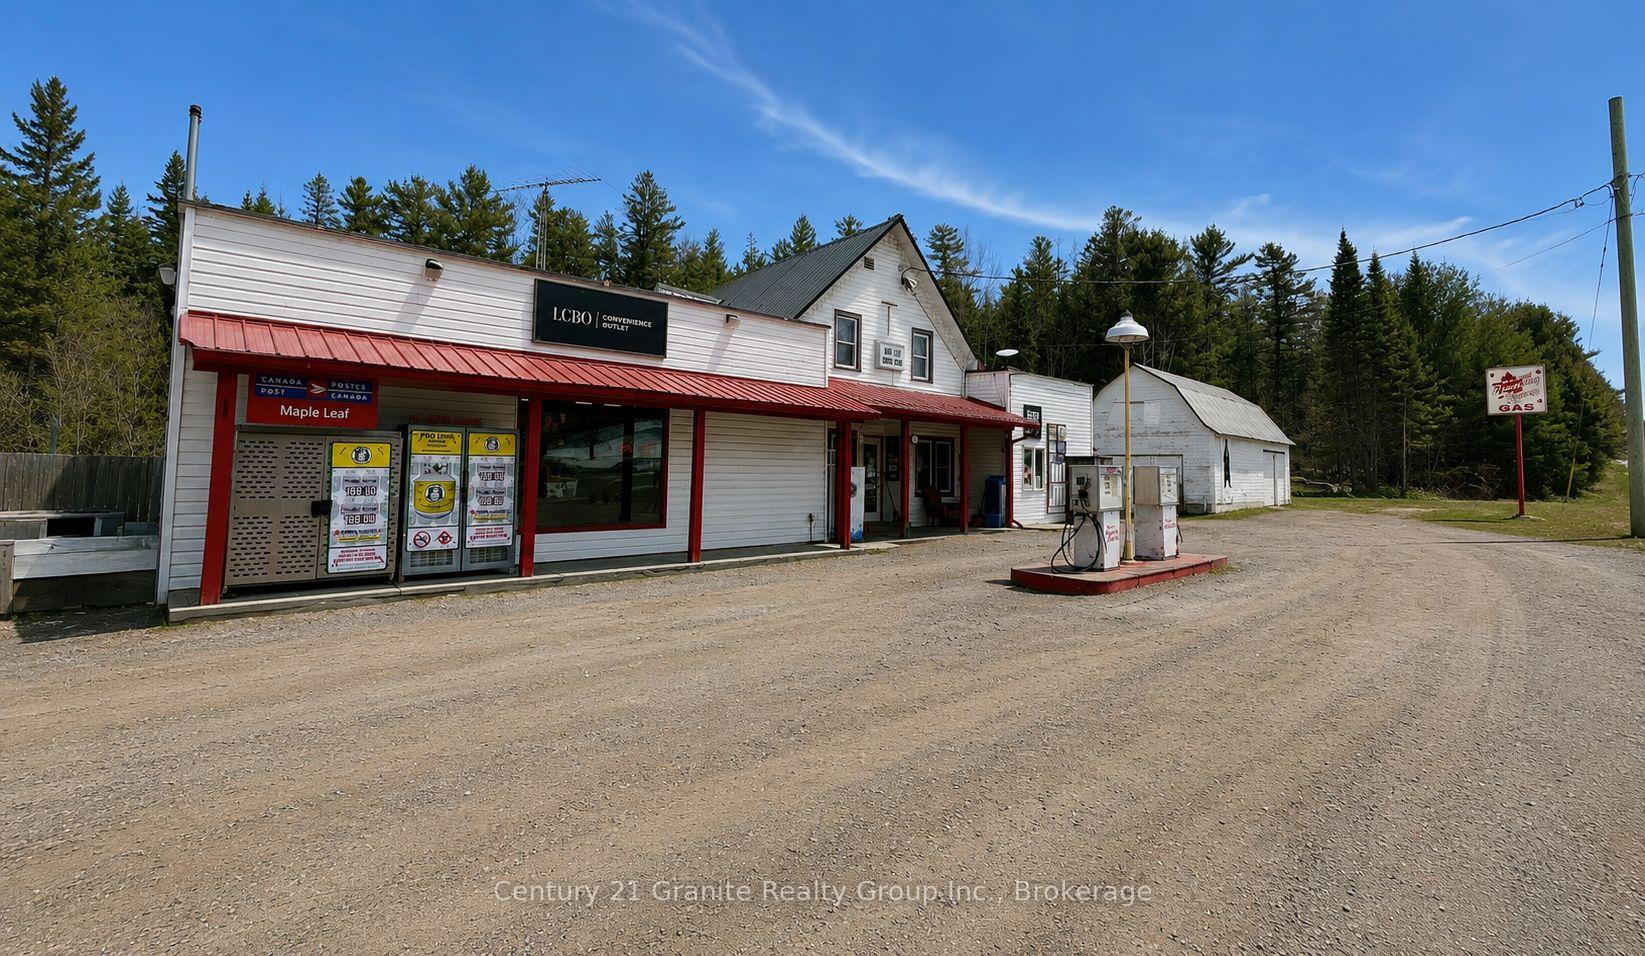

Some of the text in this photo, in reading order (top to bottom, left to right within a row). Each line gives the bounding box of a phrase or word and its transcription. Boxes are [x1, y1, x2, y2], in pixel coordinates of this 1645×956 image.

[553, 306, 592, 325] LCBO
[602, 314, 652, 328] CONVENIENCE
[602, 322, 629, 332] OUTLET
[261, 376, 302, 385] CANADA
[331, 381, 366, 391] POSTES
[260, 388, 285, 396] POST
[331, 392, 367, 401] CANADA
[280, 404, 350, 419] Maple Leaf
[1499, 403, 1534, 412] GAS
